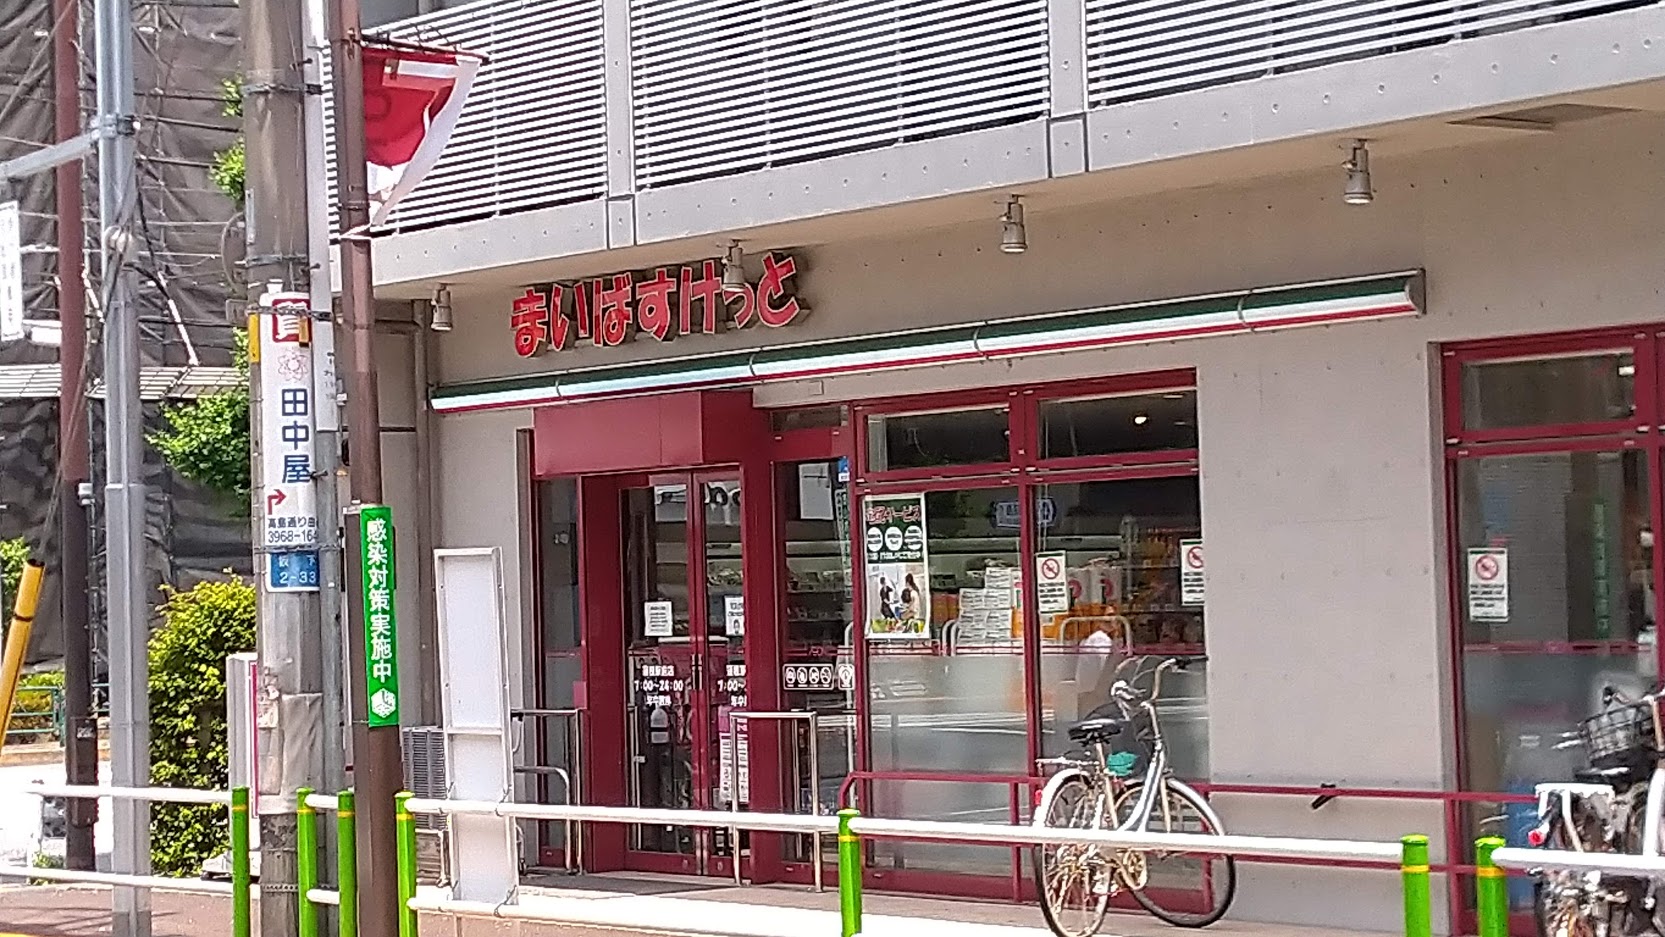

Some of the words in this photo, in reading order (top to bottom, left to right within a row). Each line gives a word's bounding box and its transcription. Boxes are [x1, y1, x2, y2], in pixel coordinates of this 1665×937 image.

[511, 252, 801, 358] まいばすけっと
[281, 388, 311, 484] 田中屋
[366, 517, 393, 683] 感染対策実施中
